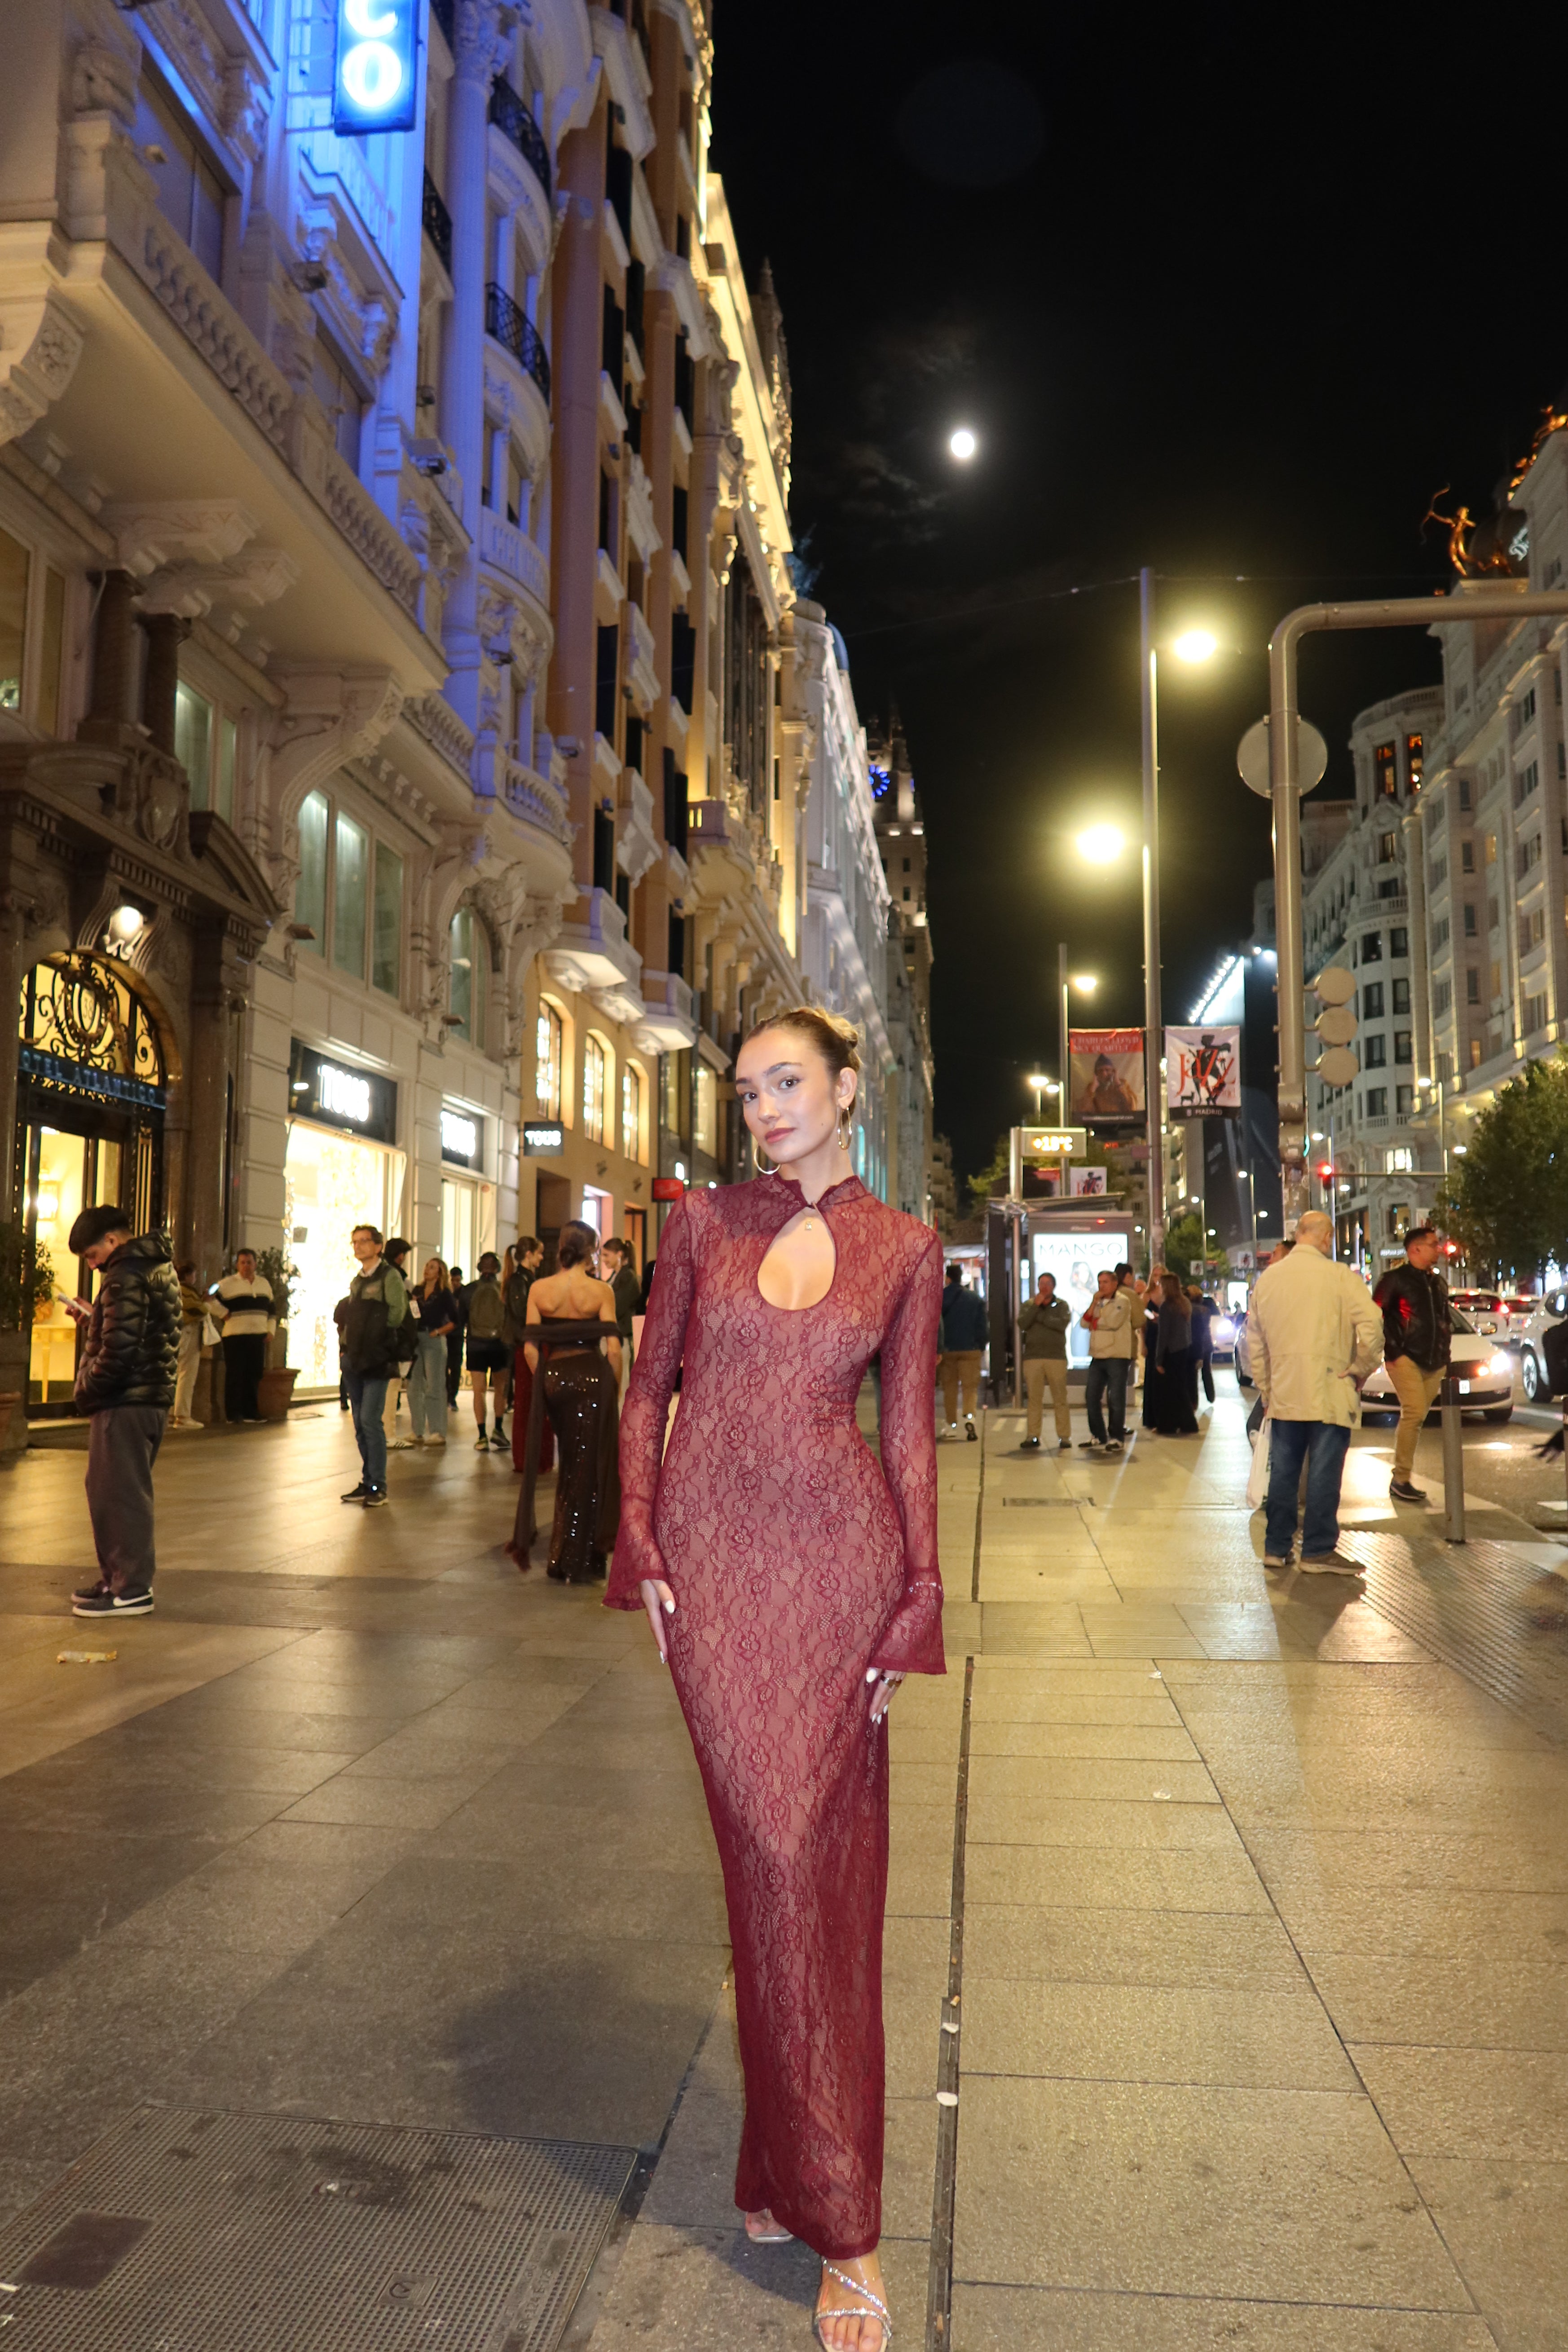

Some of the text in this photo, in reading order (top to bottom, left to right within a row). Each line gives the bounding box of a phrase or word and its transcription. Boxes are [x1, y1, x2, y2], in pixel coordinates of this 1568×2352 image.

[22, 1050, 62, 1079] OTEL
[317, 1064, 370, 1122] TOUS
[524, 1130, 561, 1146] TOUS
[1039, 1242, 1123, 1255] MANGO
